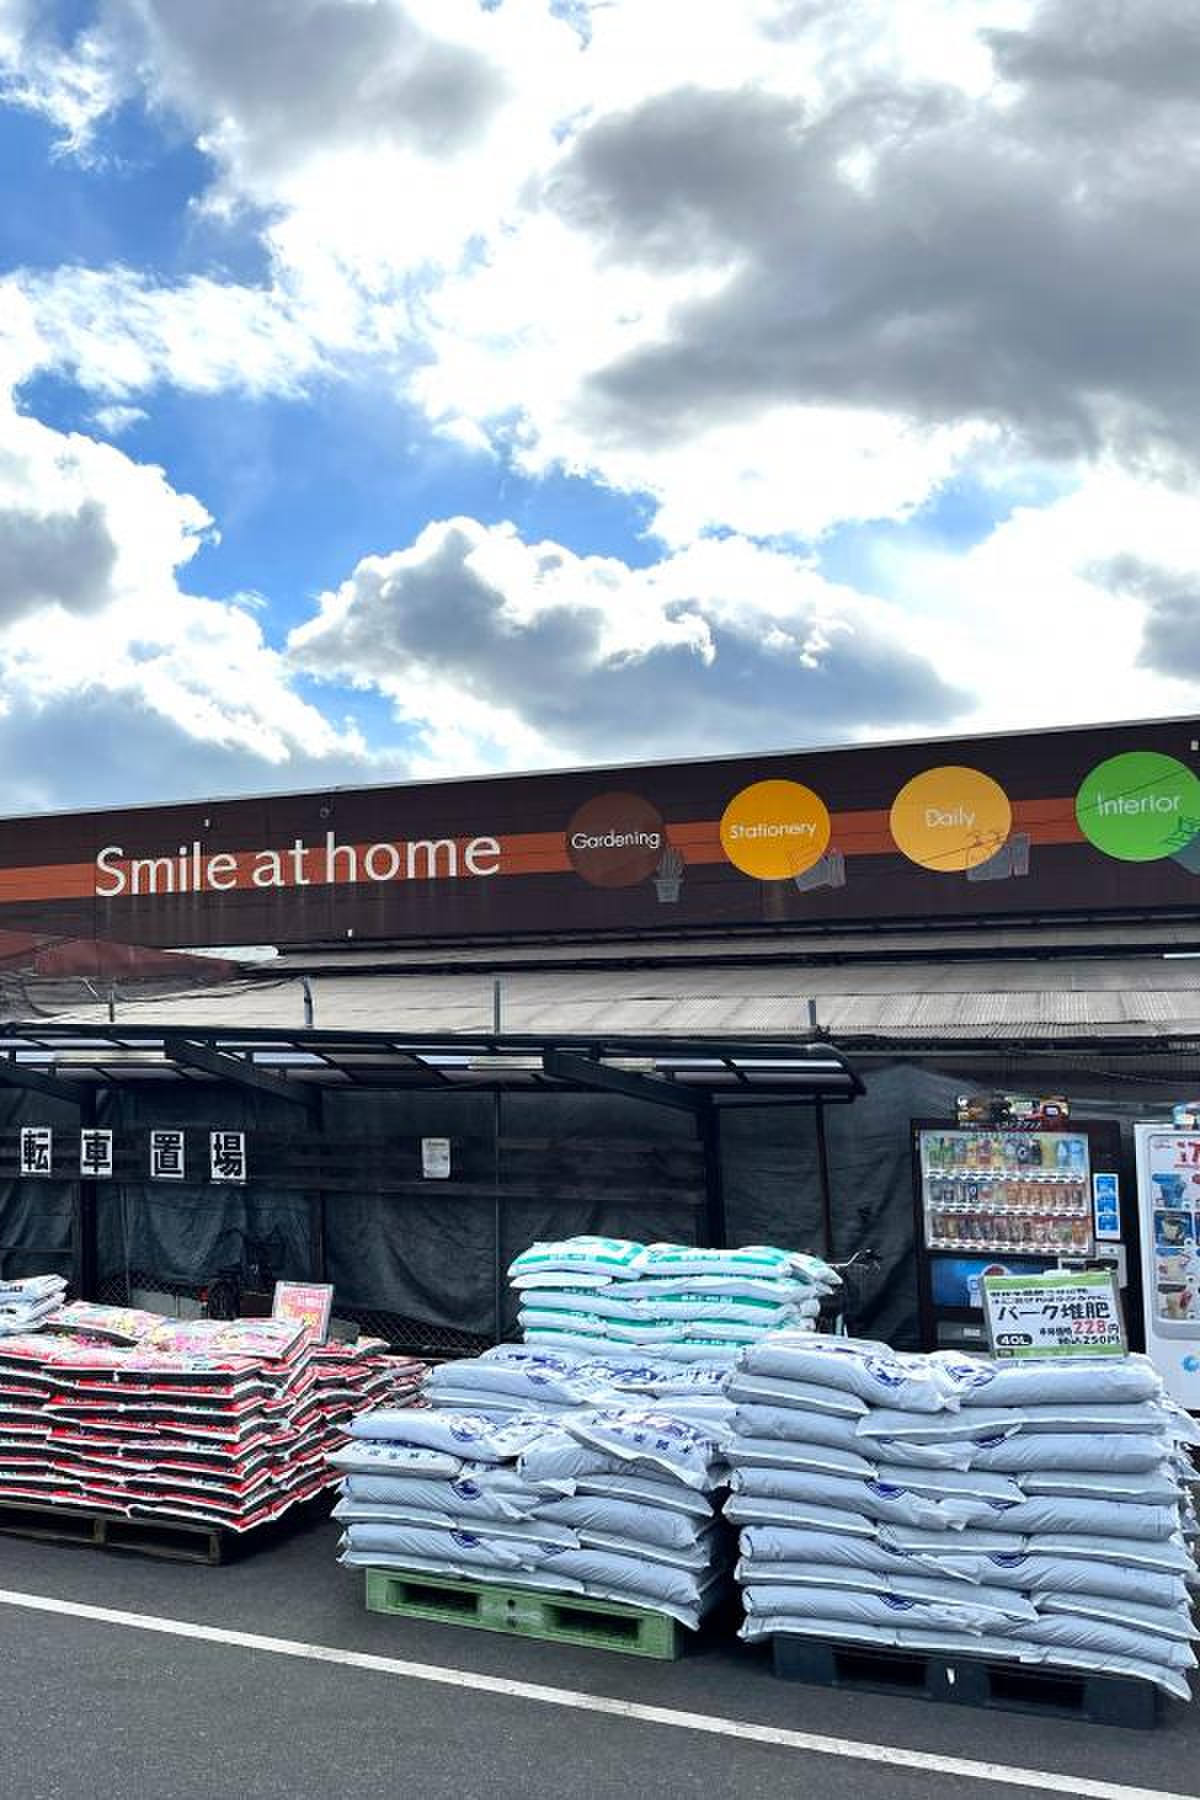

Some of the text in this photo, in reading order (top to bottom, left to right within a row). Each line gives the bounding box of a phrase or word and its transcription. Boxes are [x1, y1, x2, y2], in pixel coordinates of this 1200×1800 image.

[1096, 793, 1180, 817] Interior
[924, 807, 976, 828] Daily
[571, 828, 661, 850] Gardening
[729, 821, 817, 840] Stationery
[95, 831, 501, 897] Smile at home
[997, 1302, 1111, 1321] バーク堆肥
[1000, 1335, 1030, 1345] 40L
